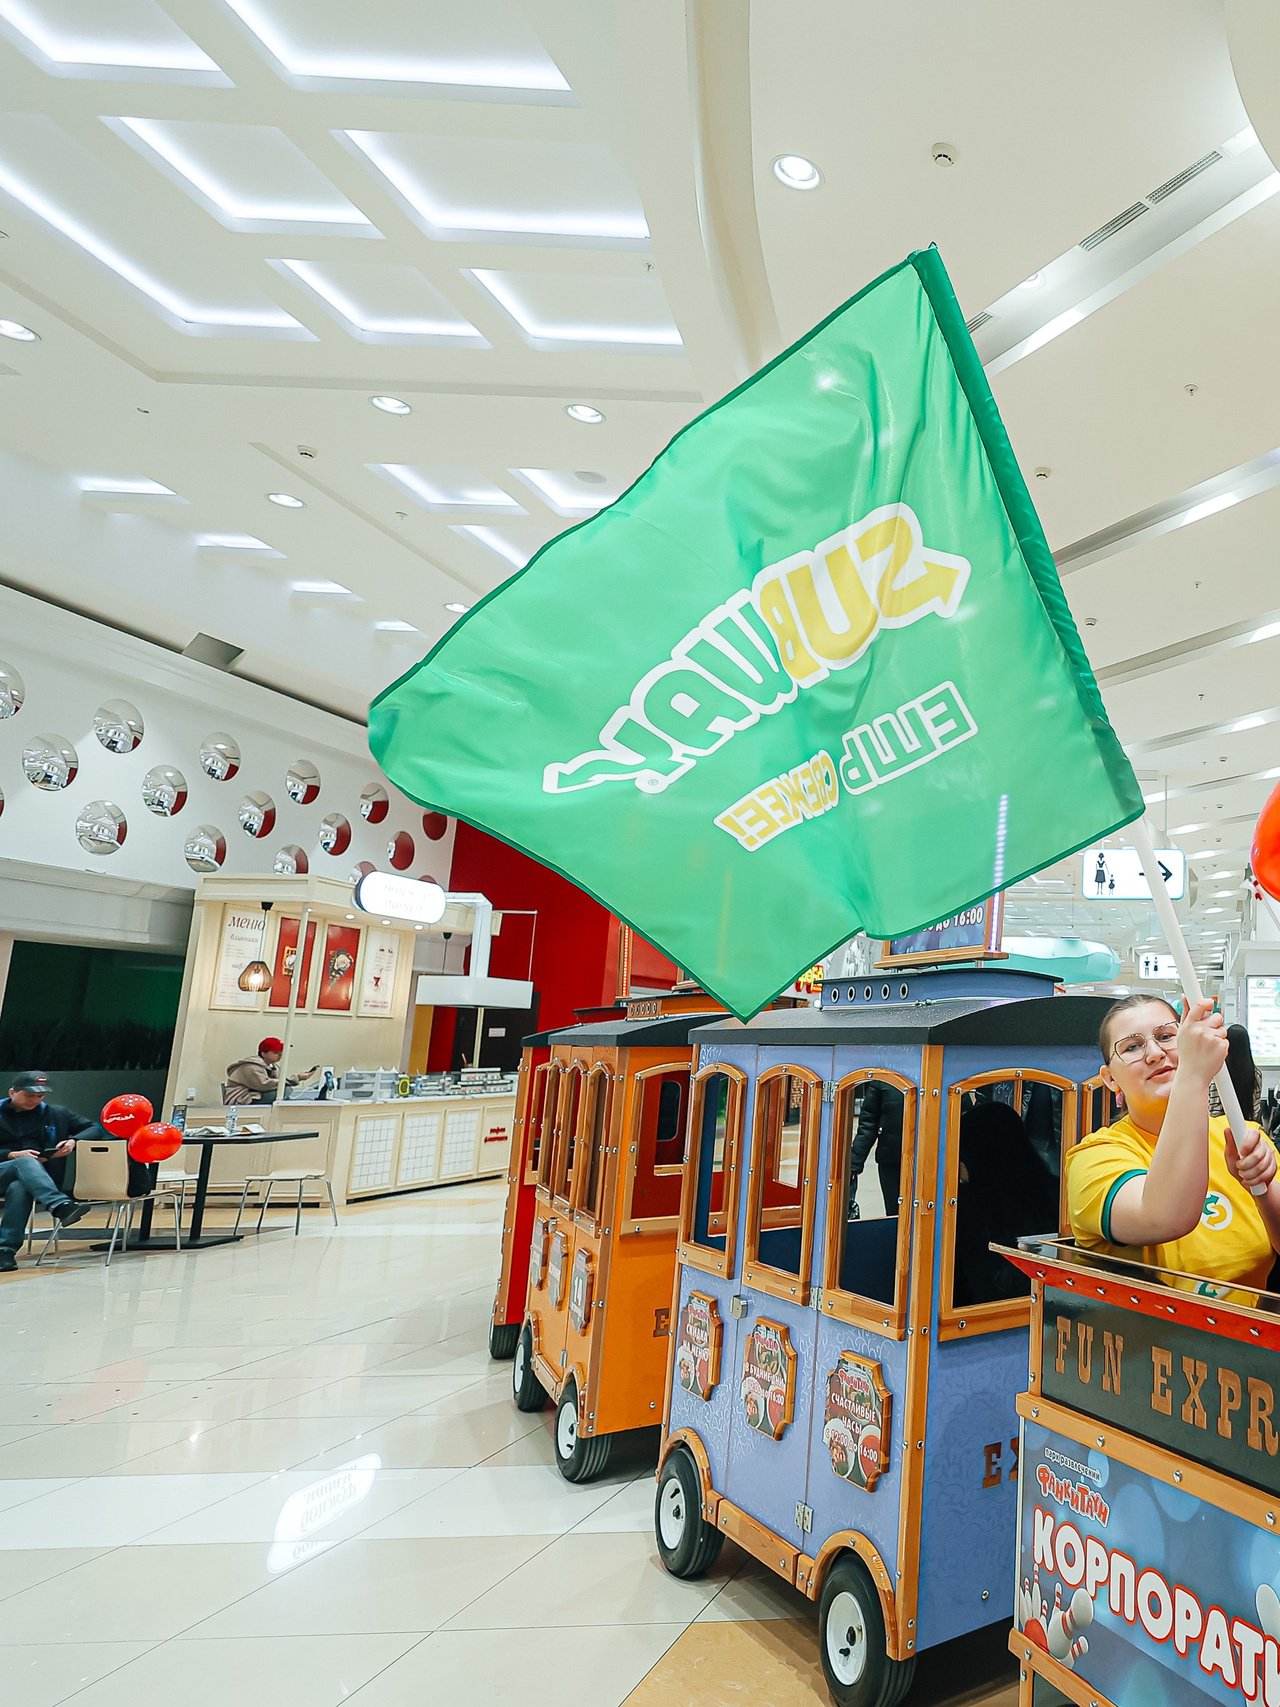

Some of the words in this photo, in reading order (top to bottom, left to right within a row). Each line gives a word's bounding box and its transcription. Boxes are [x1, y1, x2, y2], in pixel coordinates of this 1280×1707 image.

[1054, 1315, 1125, 1396] FUN
[831, 1392, 876, 1422] СЧАСТЛИВЫЕ
[842, 1416, 862, 1435] ЧАСЫ
[860, 1445, 878, 1462] 16:00
